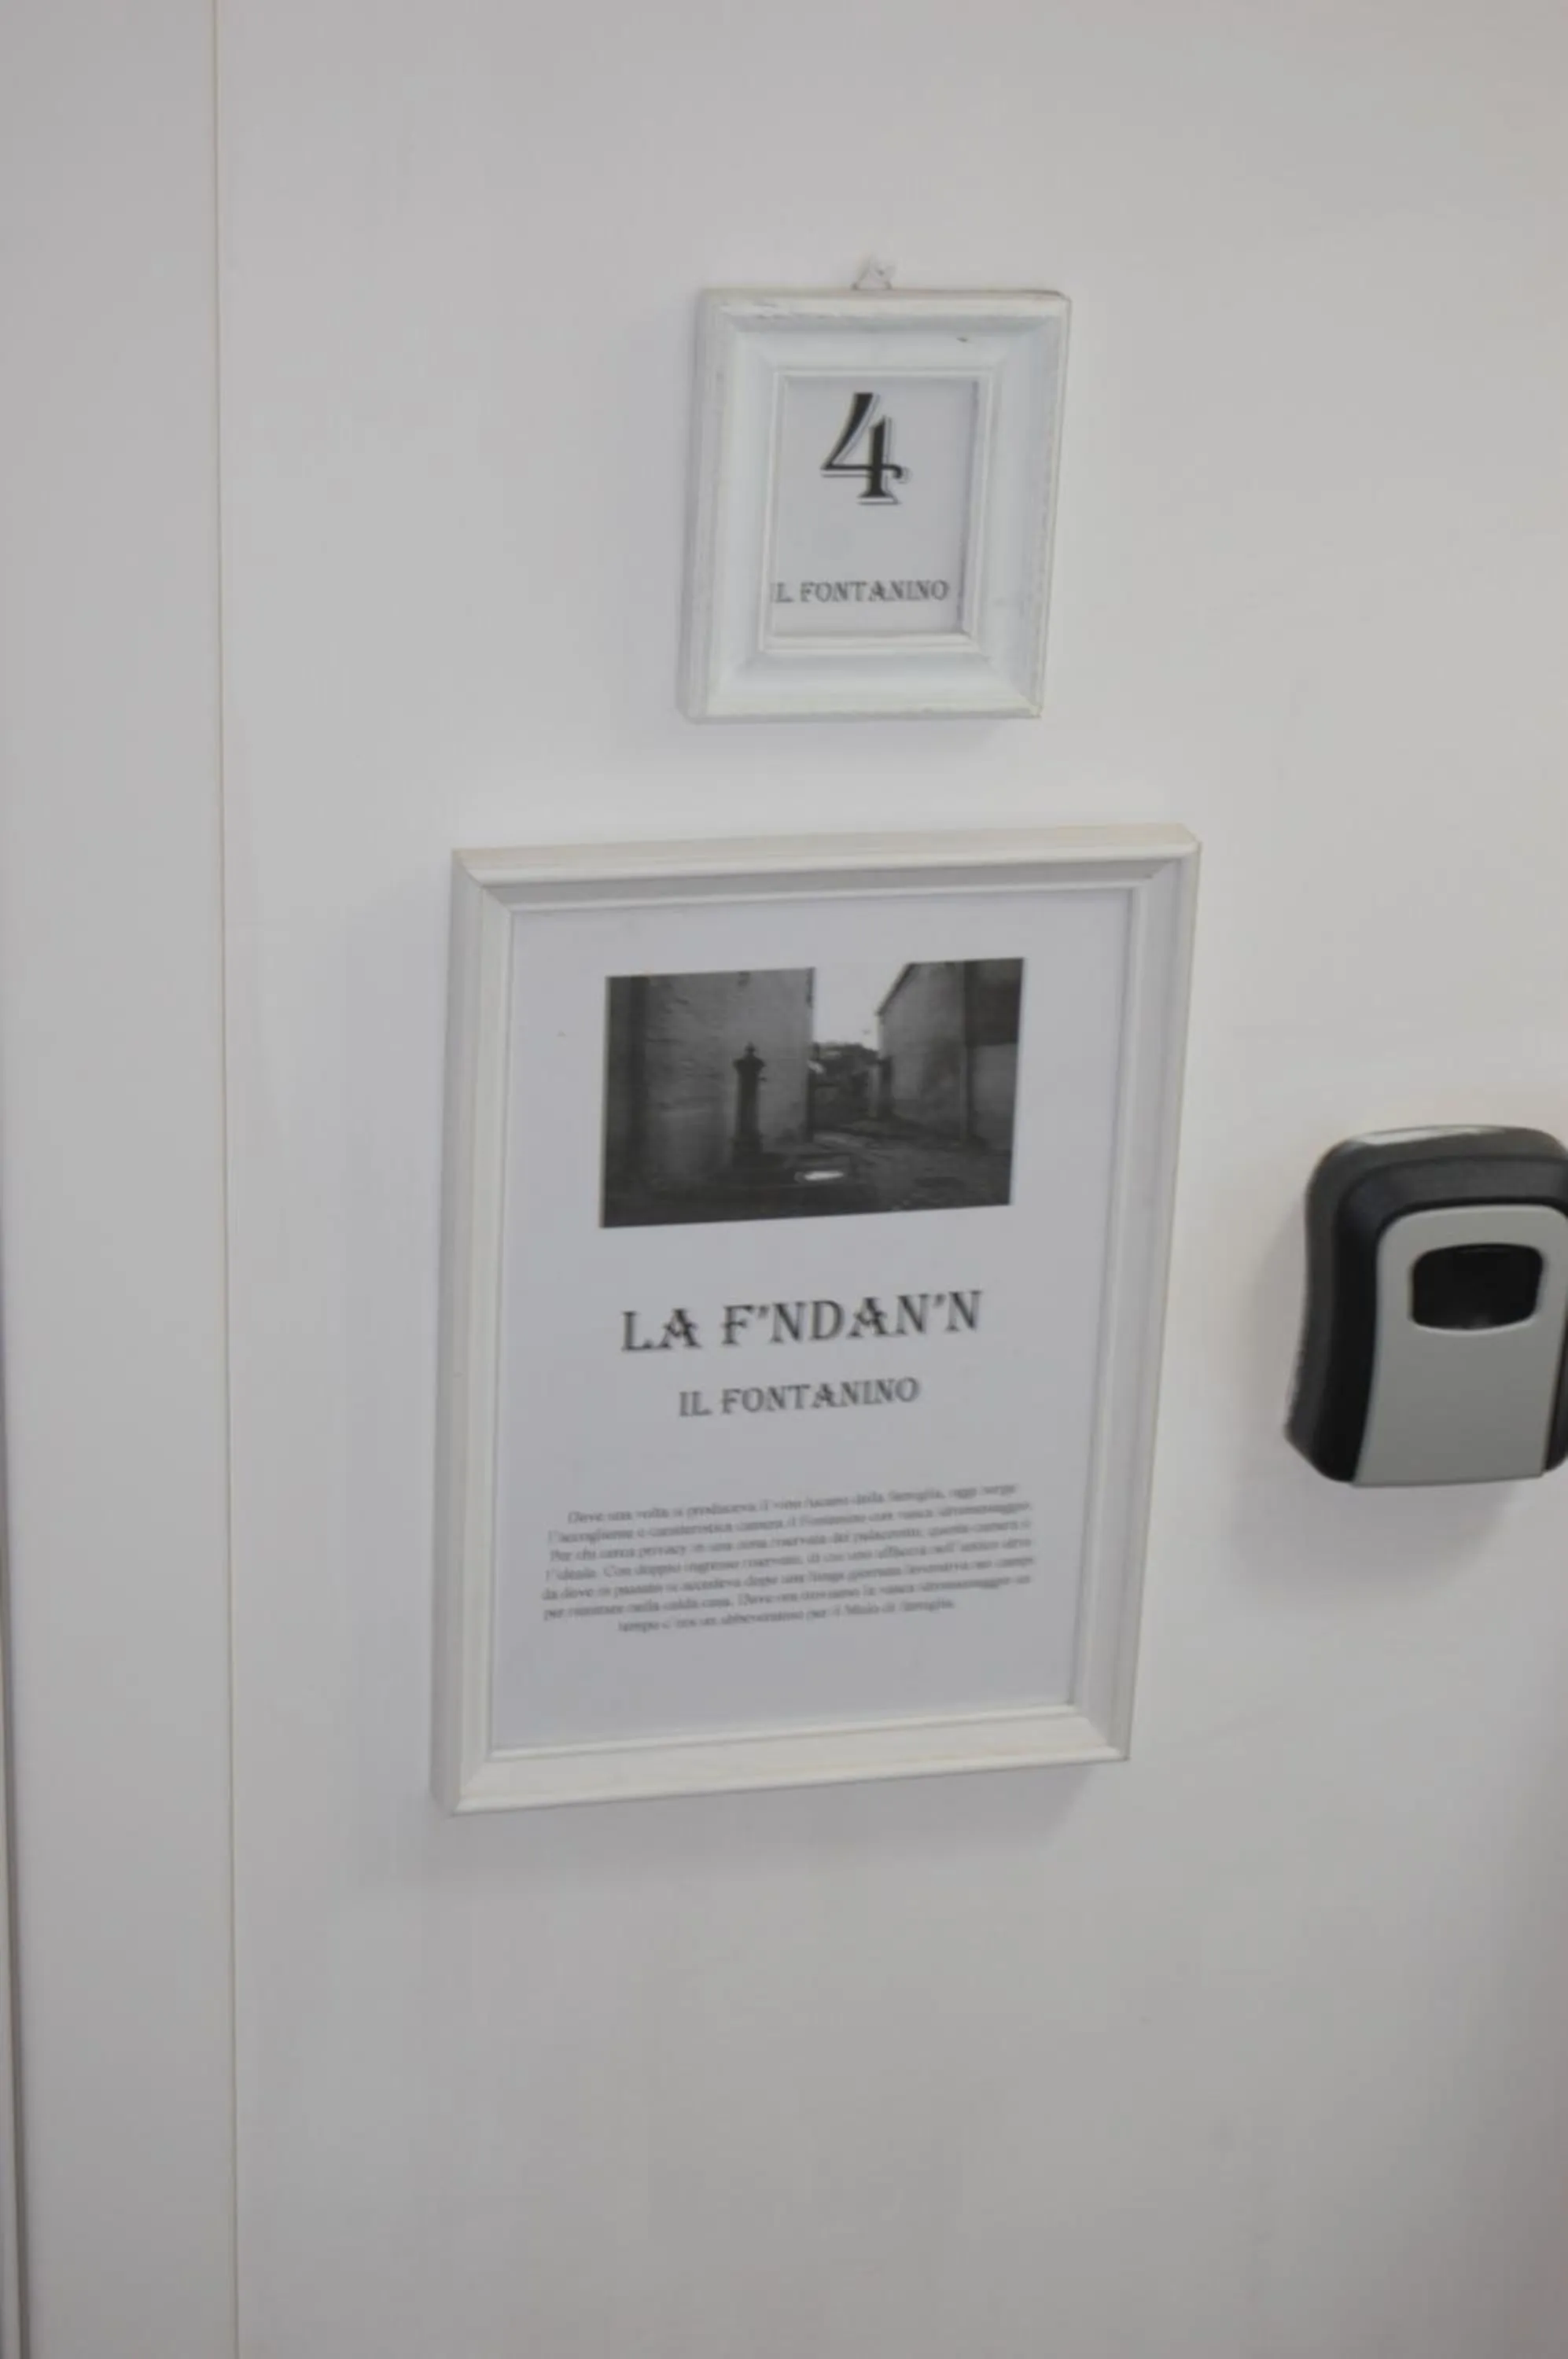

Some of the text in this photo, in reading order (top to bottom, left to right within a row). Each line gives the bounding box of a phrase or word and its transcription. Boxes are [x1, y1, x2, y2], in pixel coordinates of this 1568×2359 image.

[820, 392, 911, 506] 4
[800, 580, 950, 602] FONTANINO
[622, 1308, 702, 1352] LA
[679, 1376, 919, 1416] IL FONTANINO
